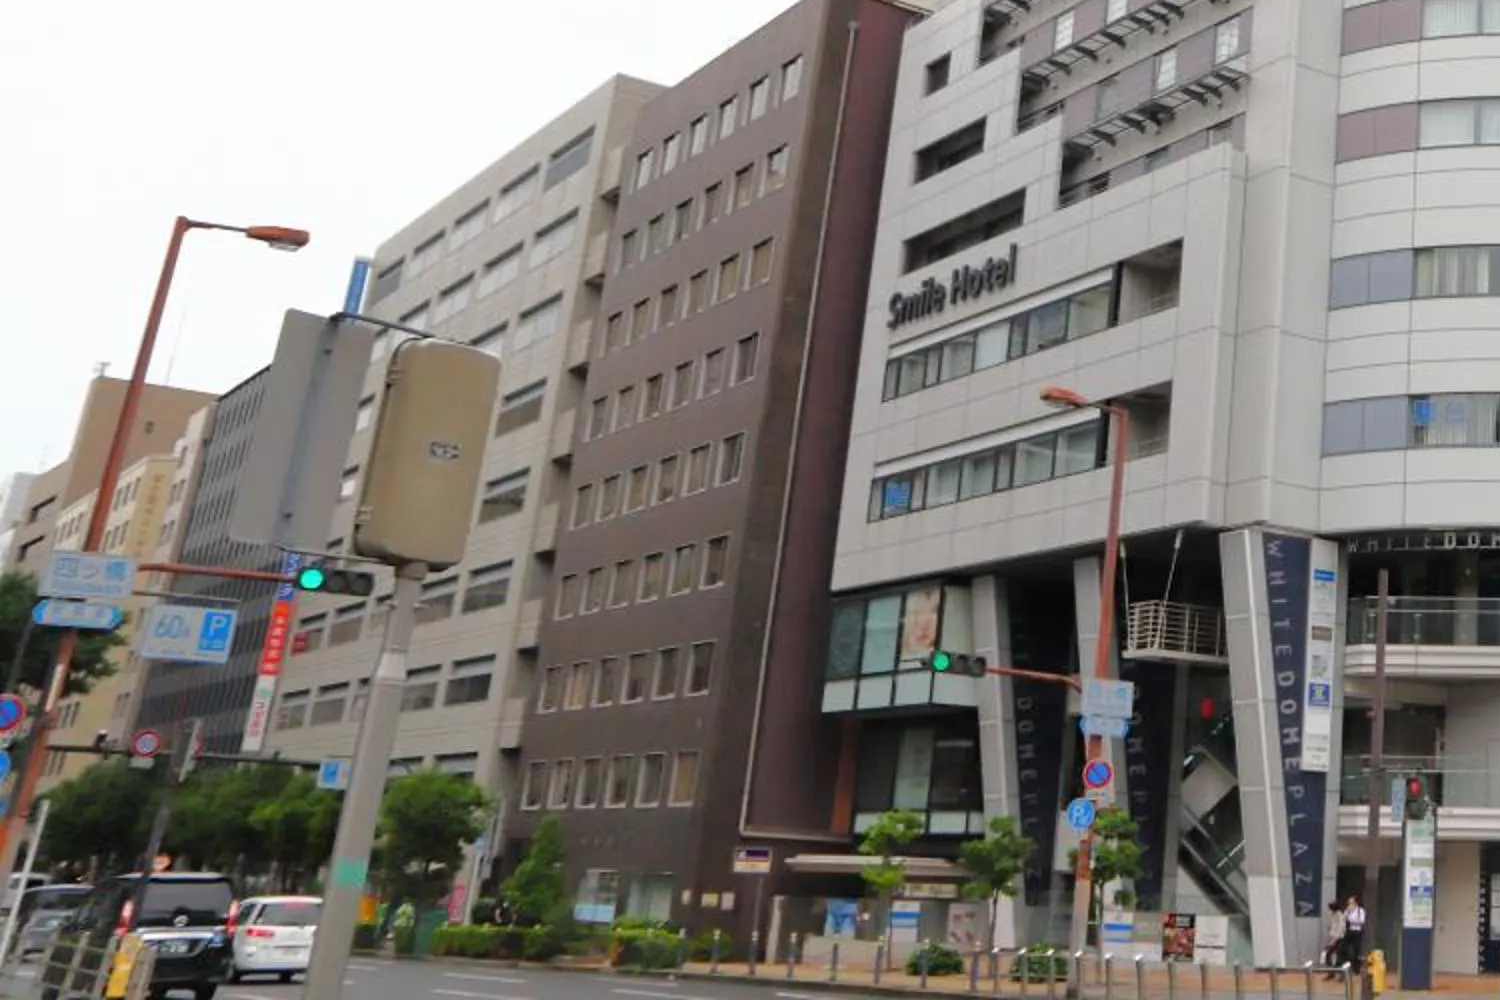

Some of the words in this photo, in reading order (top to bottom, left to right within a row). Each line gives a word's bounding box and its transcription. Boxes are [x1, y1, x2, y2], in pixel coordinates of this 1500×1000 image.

[887, 277, 946, 330] Smile
[950, 242, 1017, 305] Hotel
[1267, 540, 1292, 657] WHITE
[1277, 671, 1302, 772] DOME
